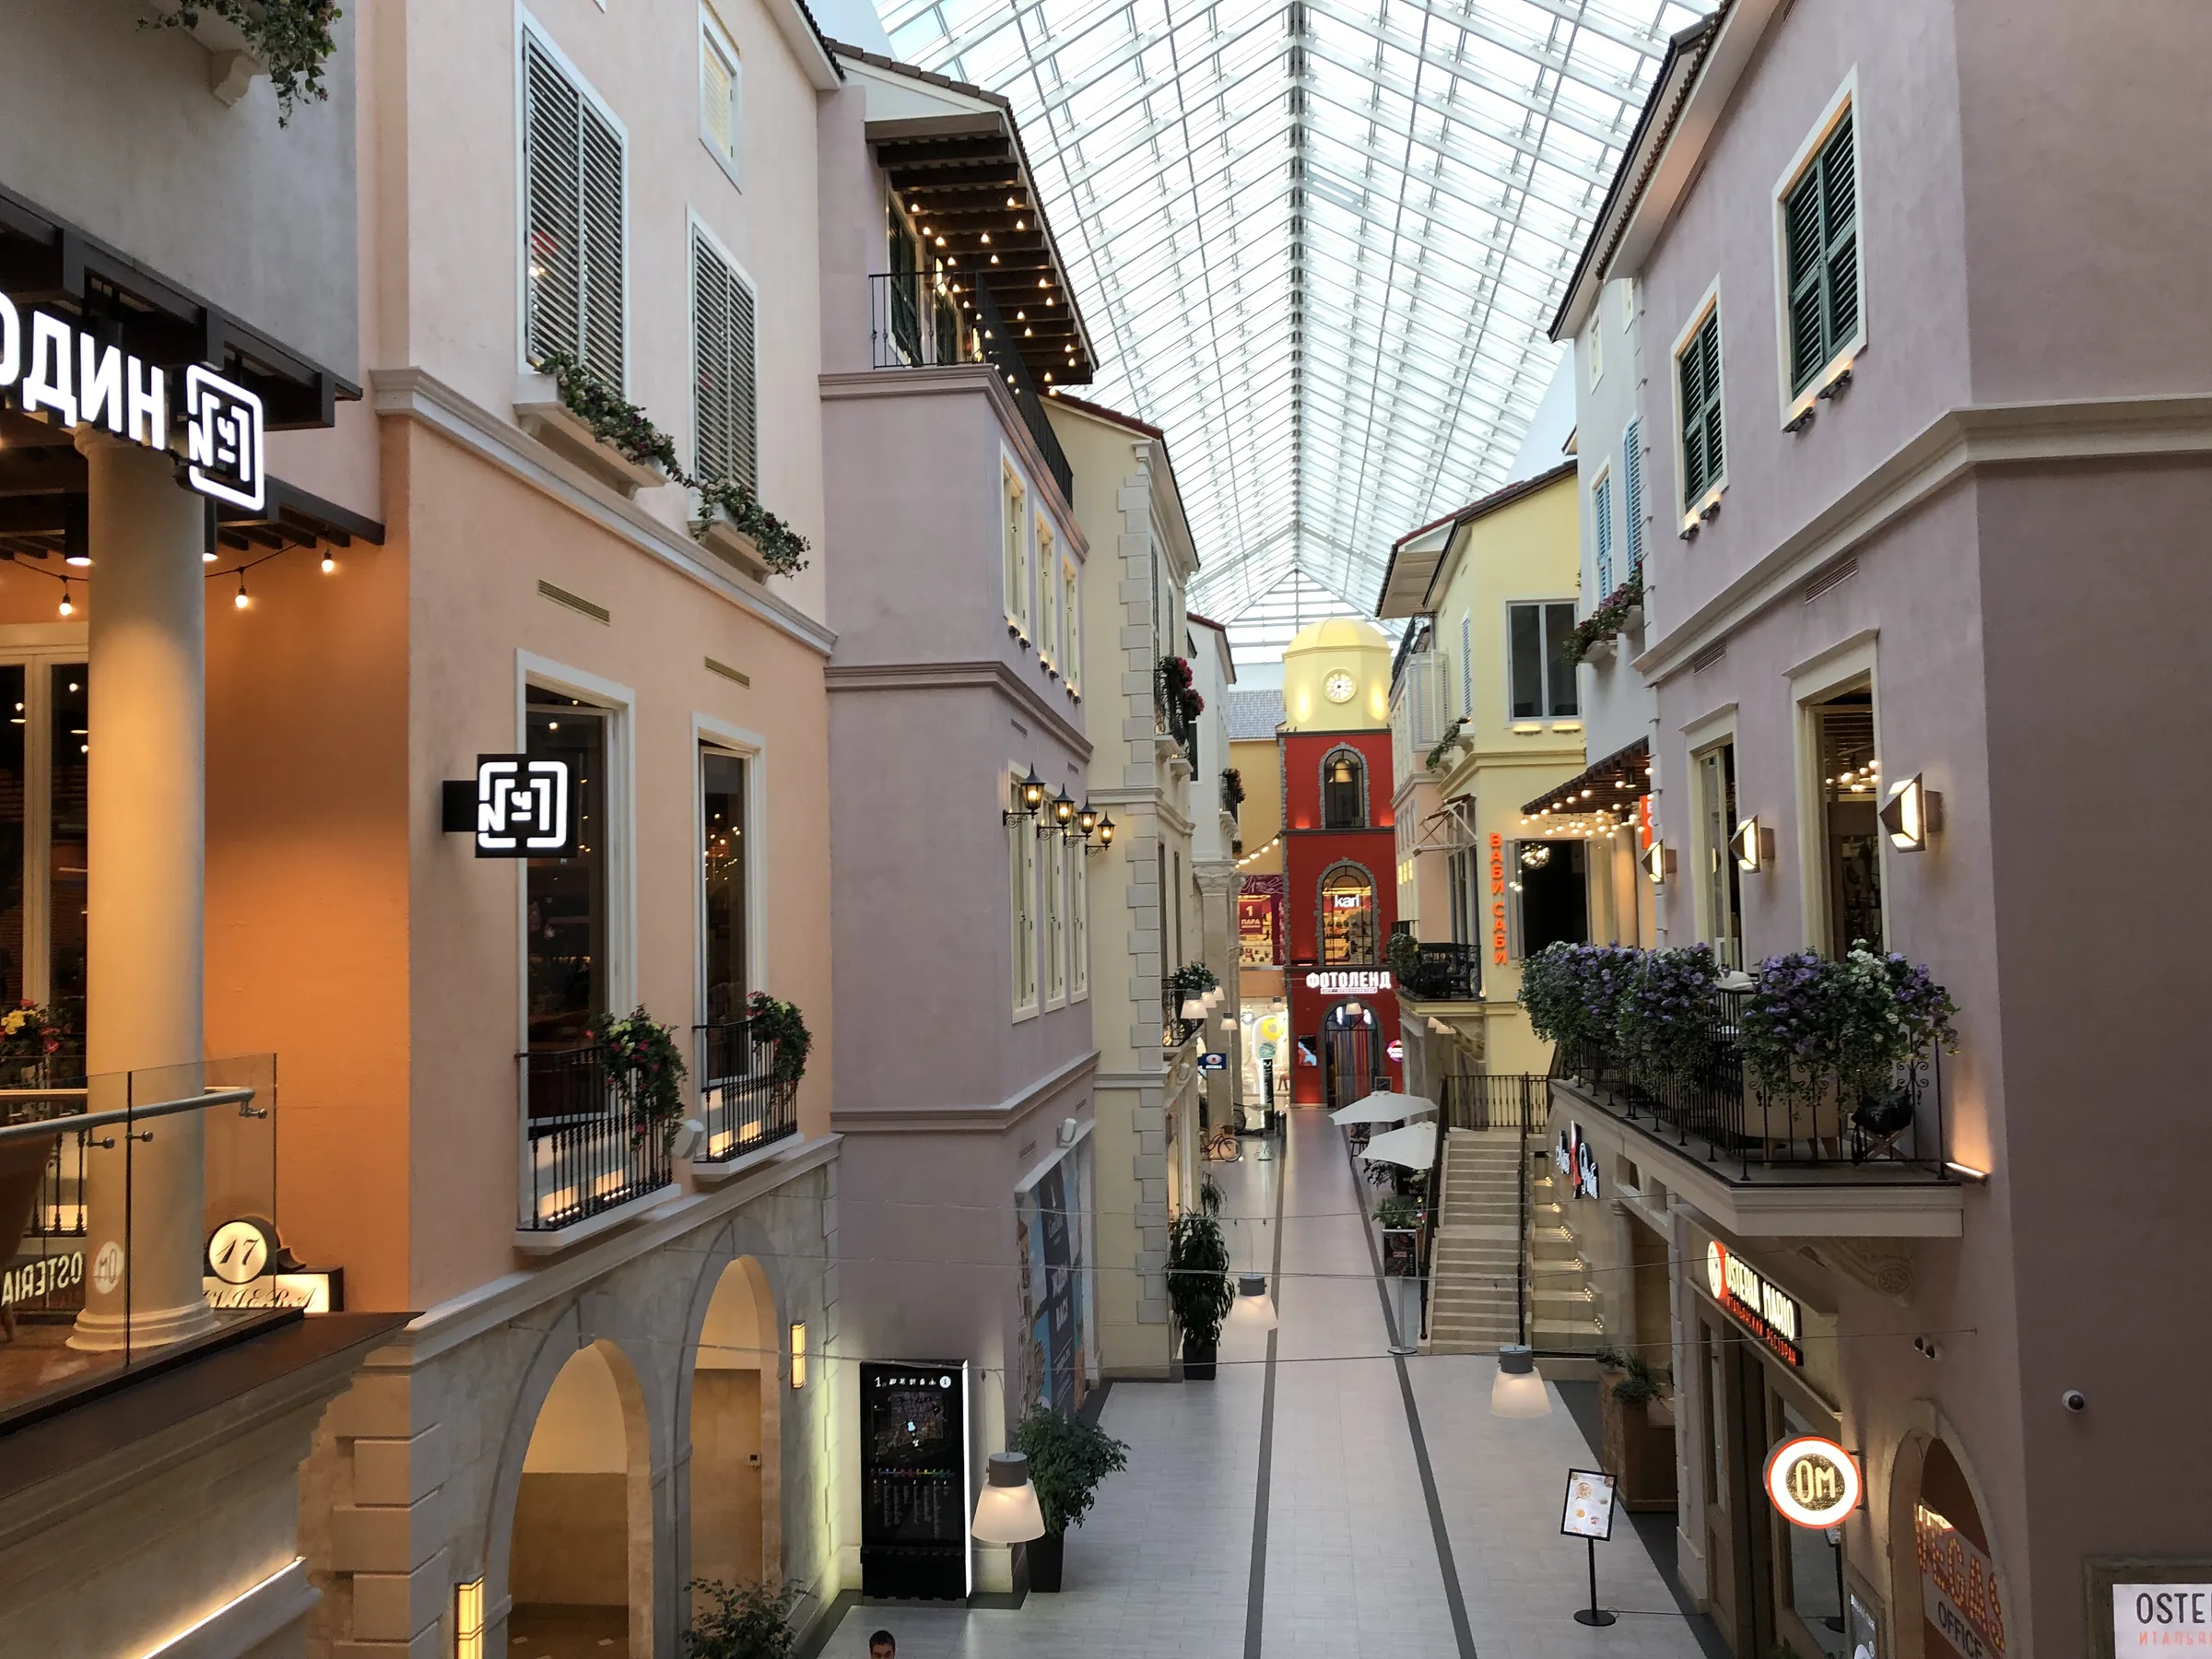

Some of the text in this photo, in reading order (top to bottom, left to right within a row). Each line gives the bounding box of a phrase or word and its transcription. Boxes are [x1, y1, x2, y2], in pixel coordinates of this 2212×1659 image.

[1334, 894, 1359, 908] kari
[1489, 832, 1508, 966] ВАБИ САБИ
[1306, 971, 1392, 989] ФОТОЛЕНД
[216, 1239, 260, 1265] 17
[1725, 1252, 1760, 1313] OSTERIA
[1762, 1281, 1794, 1341] MARIO
[2136, 1593, 2212, 1624] OSTE
[2139, 1630, 2212, 1646] ИТАЛЬЯ
